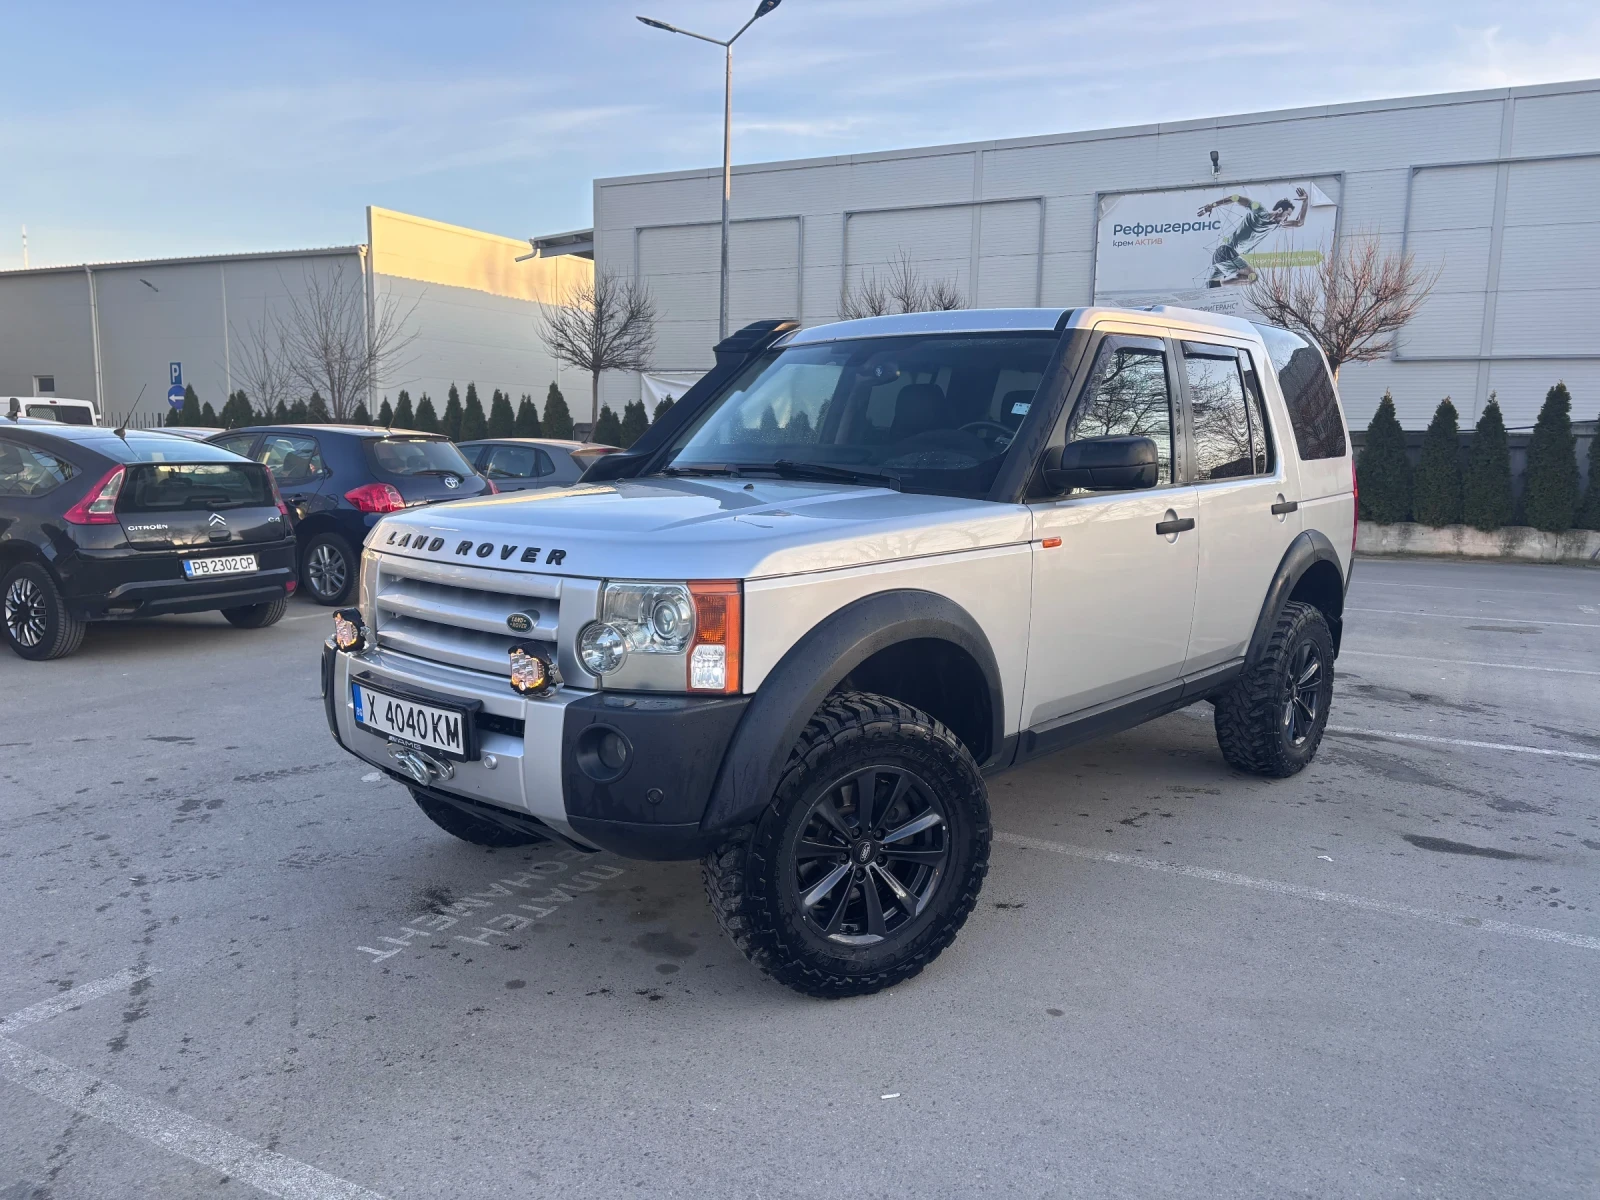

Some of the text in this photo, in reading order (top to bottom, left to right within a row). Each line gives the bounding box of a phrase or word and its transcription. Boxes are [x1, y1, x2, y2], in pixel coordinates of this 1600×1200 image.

[1113, 219, 1221, 237] Рефригеранс
[1135, 238, 1163, 246] АКТИВ
[172, 364, 180, 383] P
[127, 523, 169, 531] CITROËN
[386, 531, 568, 566] LAND ROVER
[193, 561, 210, 574] PB
[212, 558, 240, 573] 2302
[240, 557, 254, 569] CP
[366, 693, 460, 749] X 4040 KM
[397, 737, 422, 751] AMG
